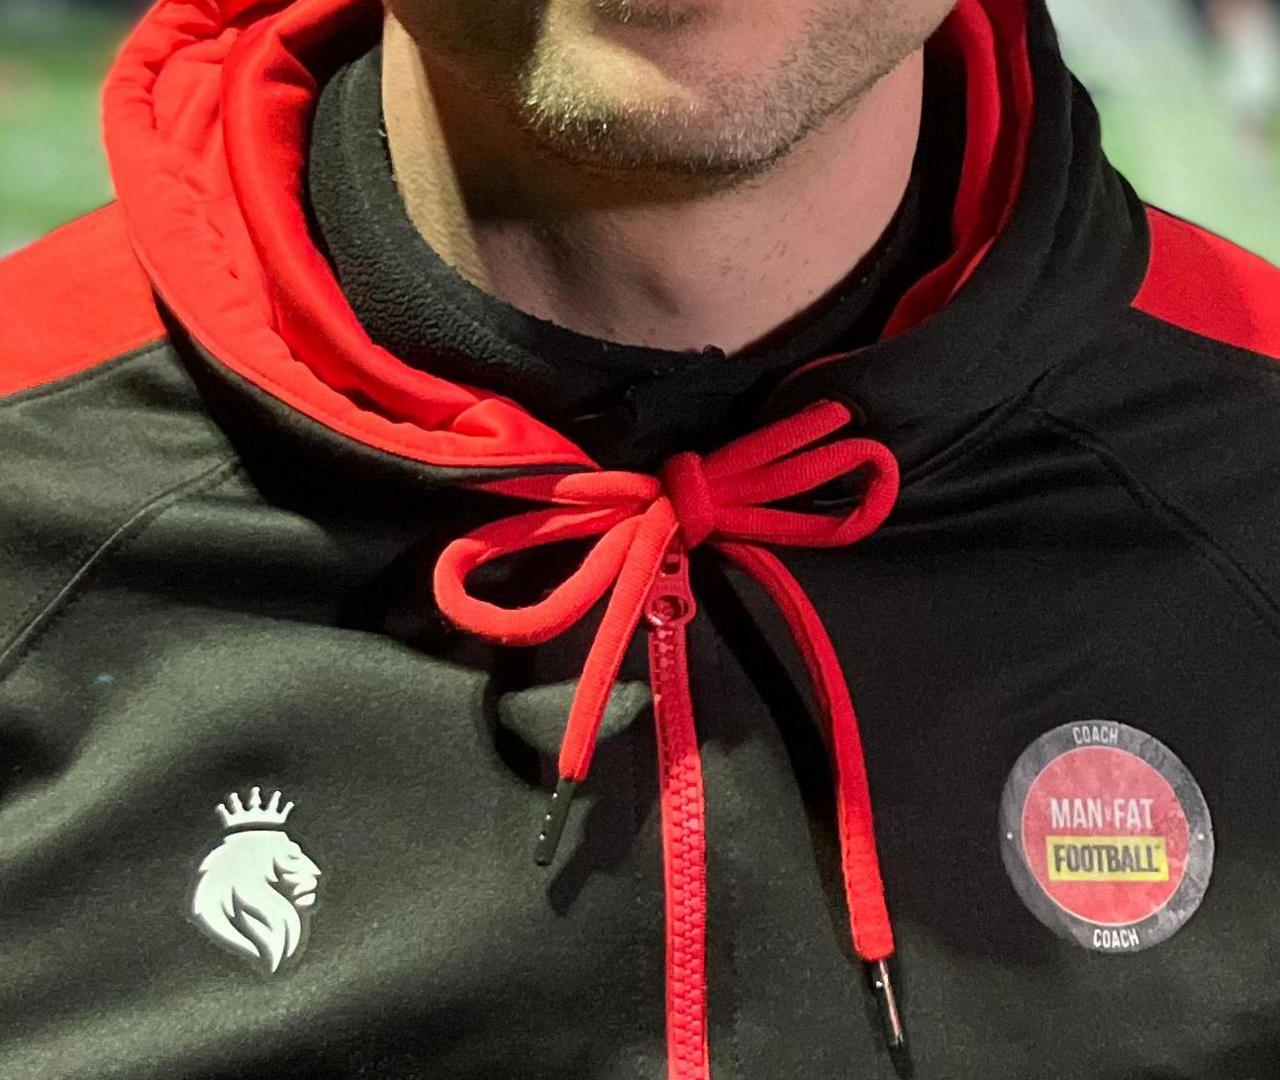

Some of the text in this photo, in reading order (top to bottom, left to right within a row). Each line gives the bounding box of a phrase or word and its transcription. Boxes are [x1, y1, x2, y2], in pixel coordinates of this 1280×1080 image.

[1073, 725, 1119, 745] COACH
[1050, 797, 1103, 829] MAN
[1113, 798, 1154, 829] FAT
[1093, 927, 1140, 949] COACH
